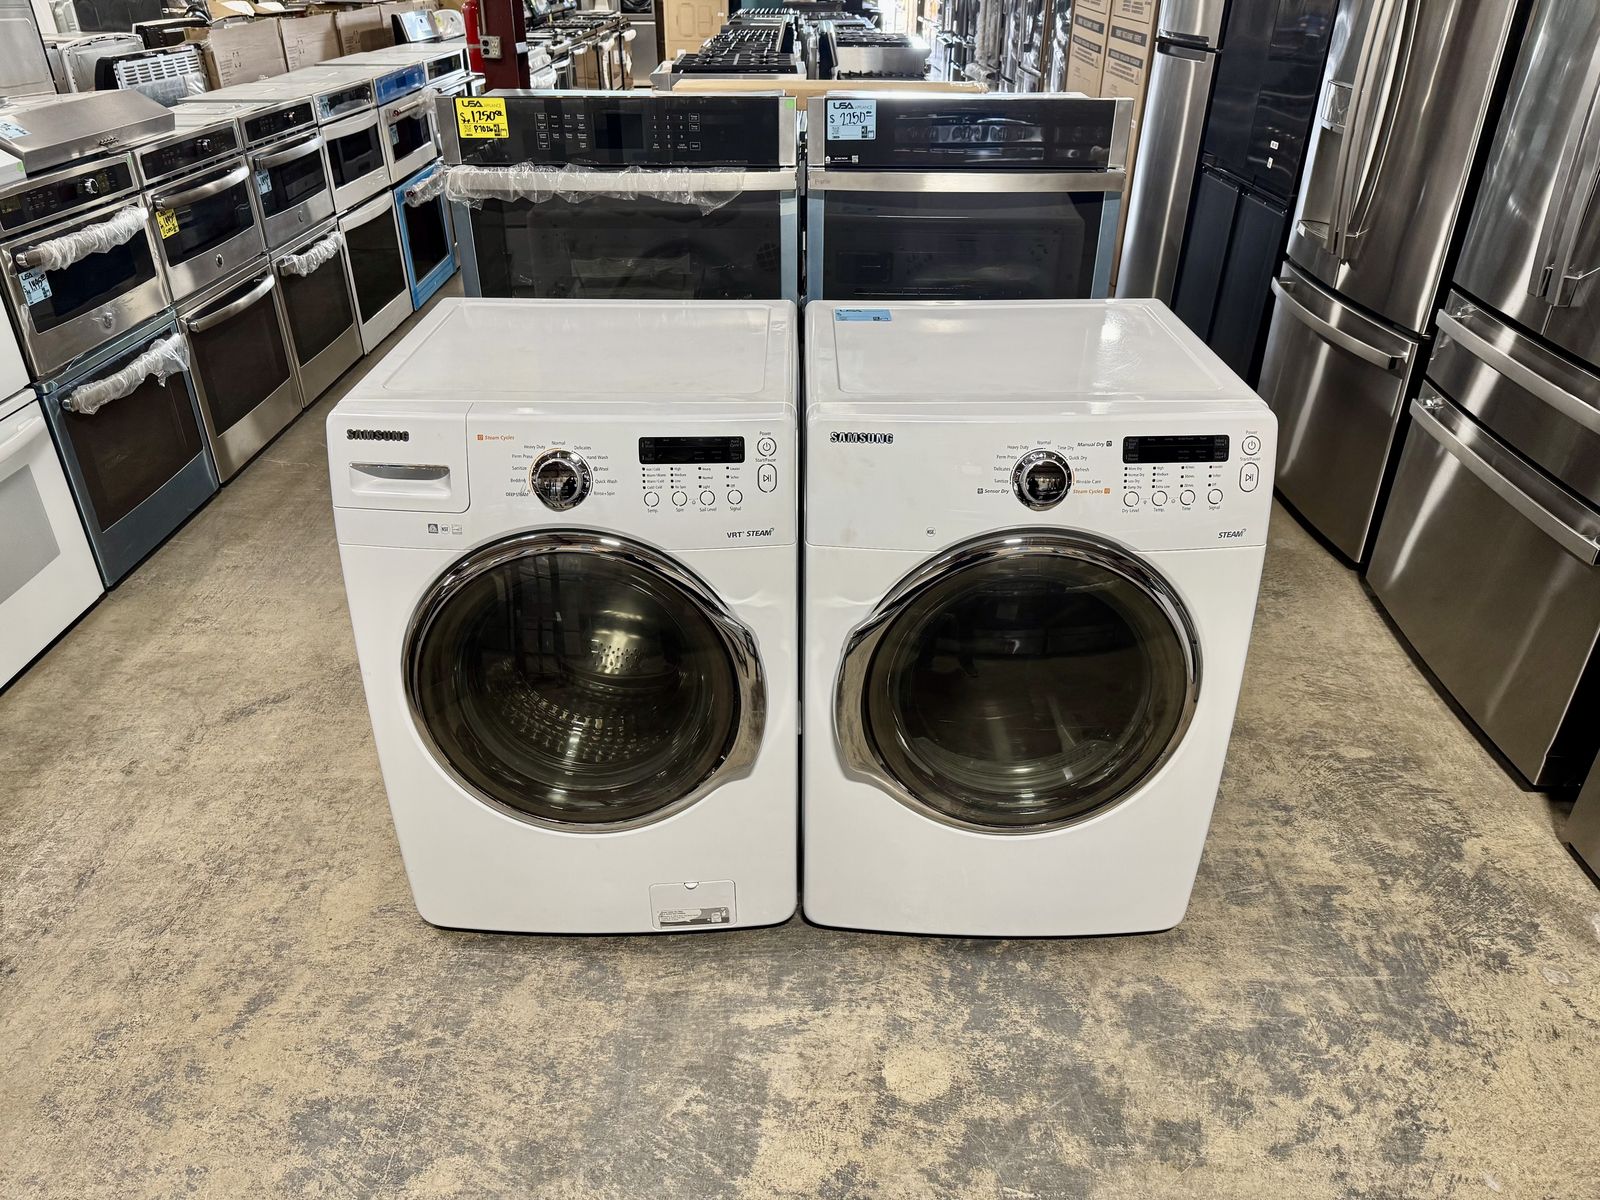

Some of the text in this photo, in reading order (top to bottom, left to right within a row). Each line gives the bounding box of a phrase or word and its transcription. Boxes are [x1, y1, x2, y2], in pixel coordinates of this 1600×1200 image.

[346, 429, 410, 442] SAMSUNG
[830, 432, 894, 444] SAMSUNG
[746, 529, 773, 538] STEAM
[1218, 530, 1244, 538] STEAM
